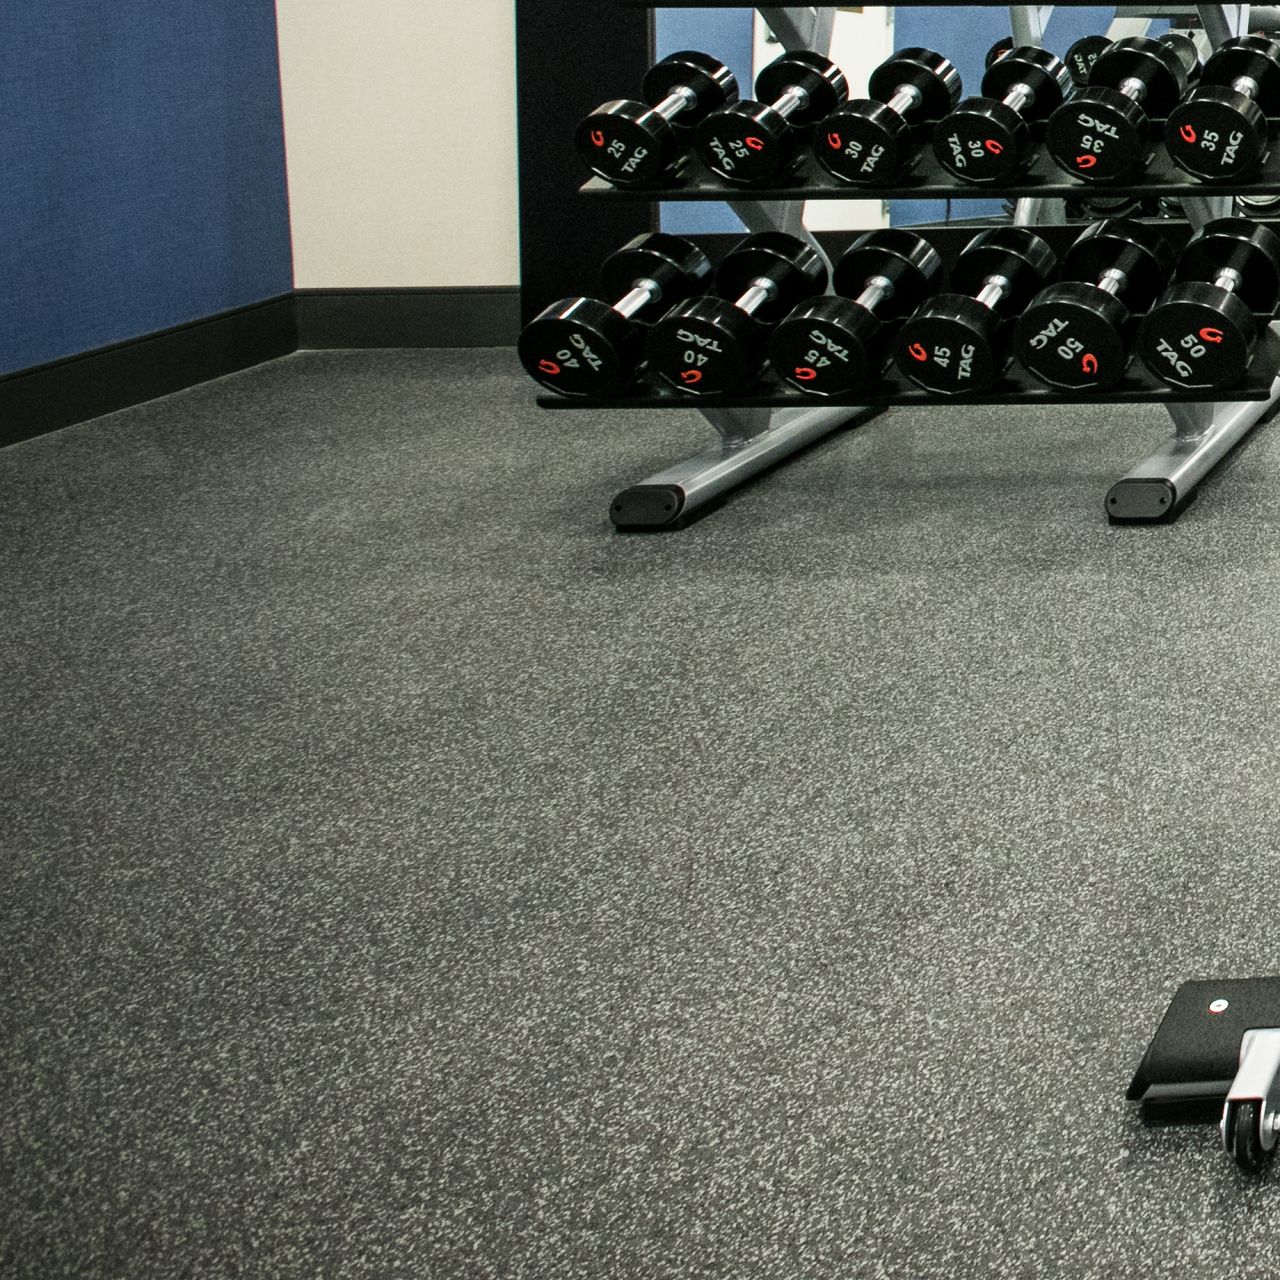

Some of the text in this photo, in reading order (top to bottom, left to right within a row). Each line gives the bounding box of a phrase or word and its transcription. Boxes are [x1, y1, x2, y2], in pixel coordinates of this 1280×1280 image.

[1077, 112, 1120, 140] TAG
[607, 139, 626, 159] 25
[728, 139, 750, 158] 25
[845, 141, 862, 158] 30
[948, 132, 966, 168] TAG
[968, 140, 984, 158] 30
[1080, 134, 1104, 154] 35
[1200, 129, 1219, 152] 35
[1220, 130, 1244, 167] TAG
[621, 146, 648, 173] TAG
[709, 136, 736, 171] TAG
[859, 144, 885, 173] TAG
[676, 328, 723, 353] TAG
[808, 329, 850, 363] TAG
[1029, 317, 1070, 350] TAG
[1180, 333, 1206, 358] 50
[556, 349, 580, 368] 40
[569, 333, 603, 371] TAG
[683, 349, 709, 367] 40
[804, 349, 832, 368] 45
[933, 345, 951, 368] 45
[1057, 337, 1085, 360] 50
[1155, 337, 1193, 378] TAG
[957, 343, 976, 380] TAG
